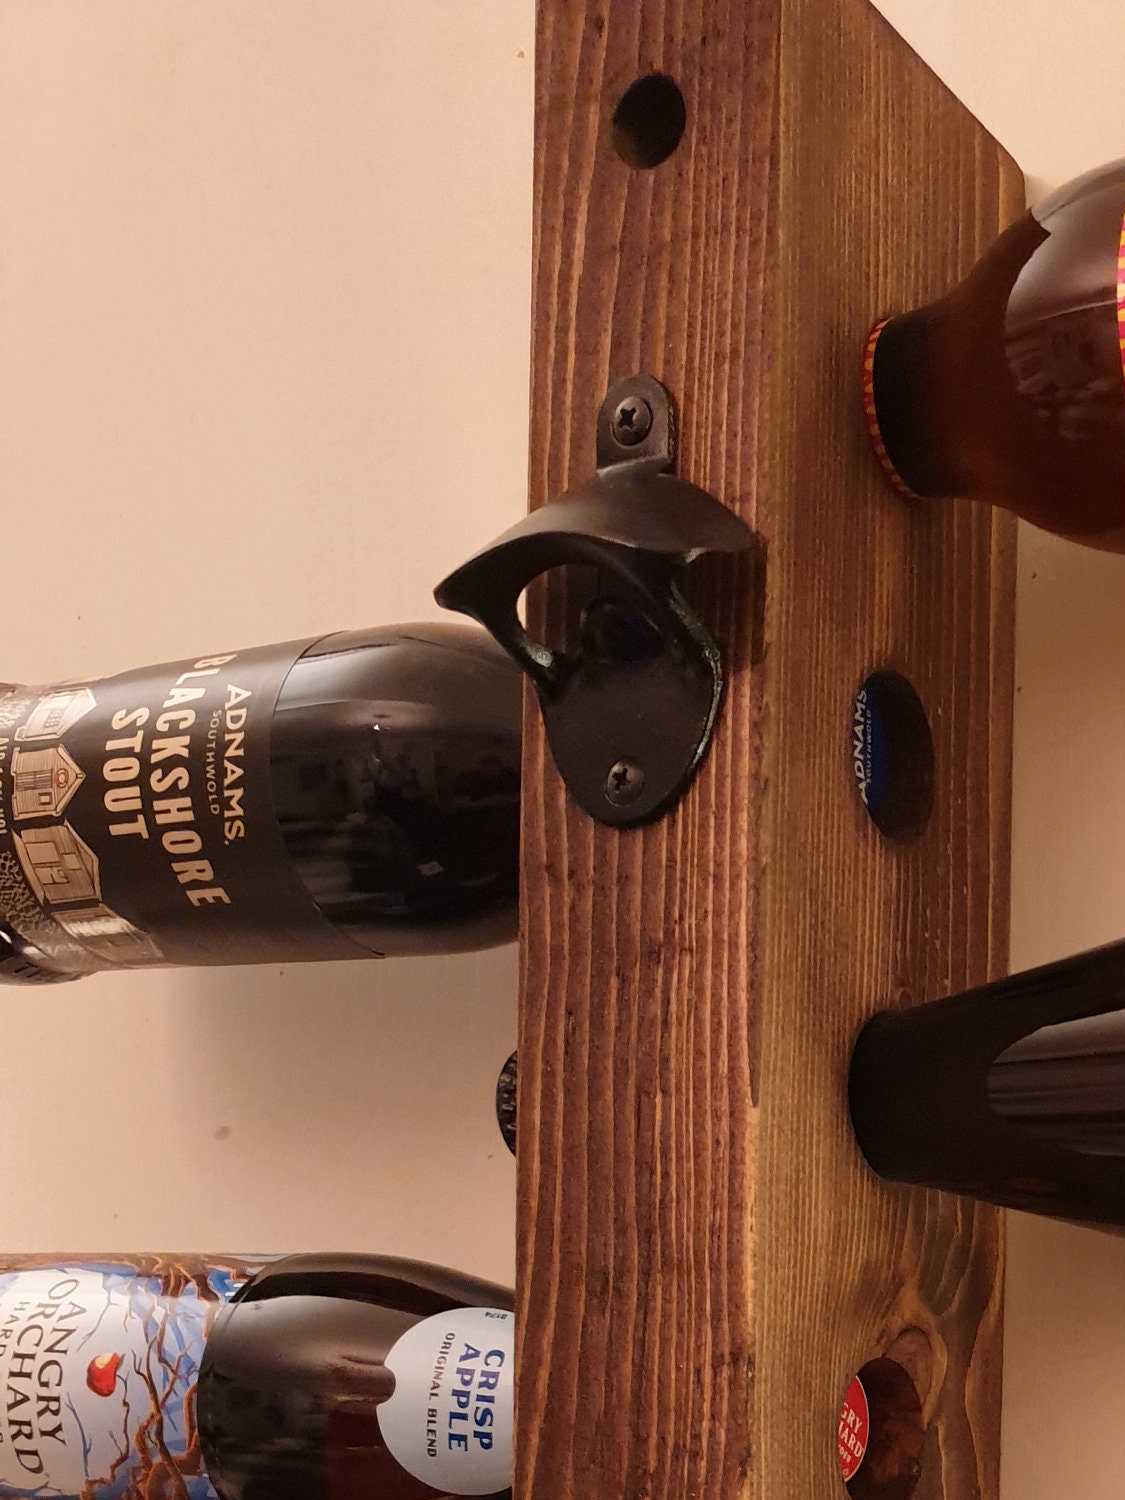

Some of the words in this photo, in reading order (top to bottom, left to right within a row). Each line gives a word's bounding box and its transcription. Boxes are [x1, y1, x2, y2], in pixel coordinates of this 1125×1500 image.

[102, 707, 150, 839] STOUT
[150, 654, 238, 906] BLACKSHORE
[205, 710, 223, 815] SOUTHWOLD
[853, 688, 869, 805] ADNAMS
[7, 1279, 80, 1475] ORCHARD
[36, 1302, 88, 1447] ANGRY
[429, 1332, 455, 1400] ORIGINAL
[448, 1343, 481, 1452] APPLE
[473, 1349, 505, 1450] CRISP
[427, 1408, 437, 1457] BLEND
